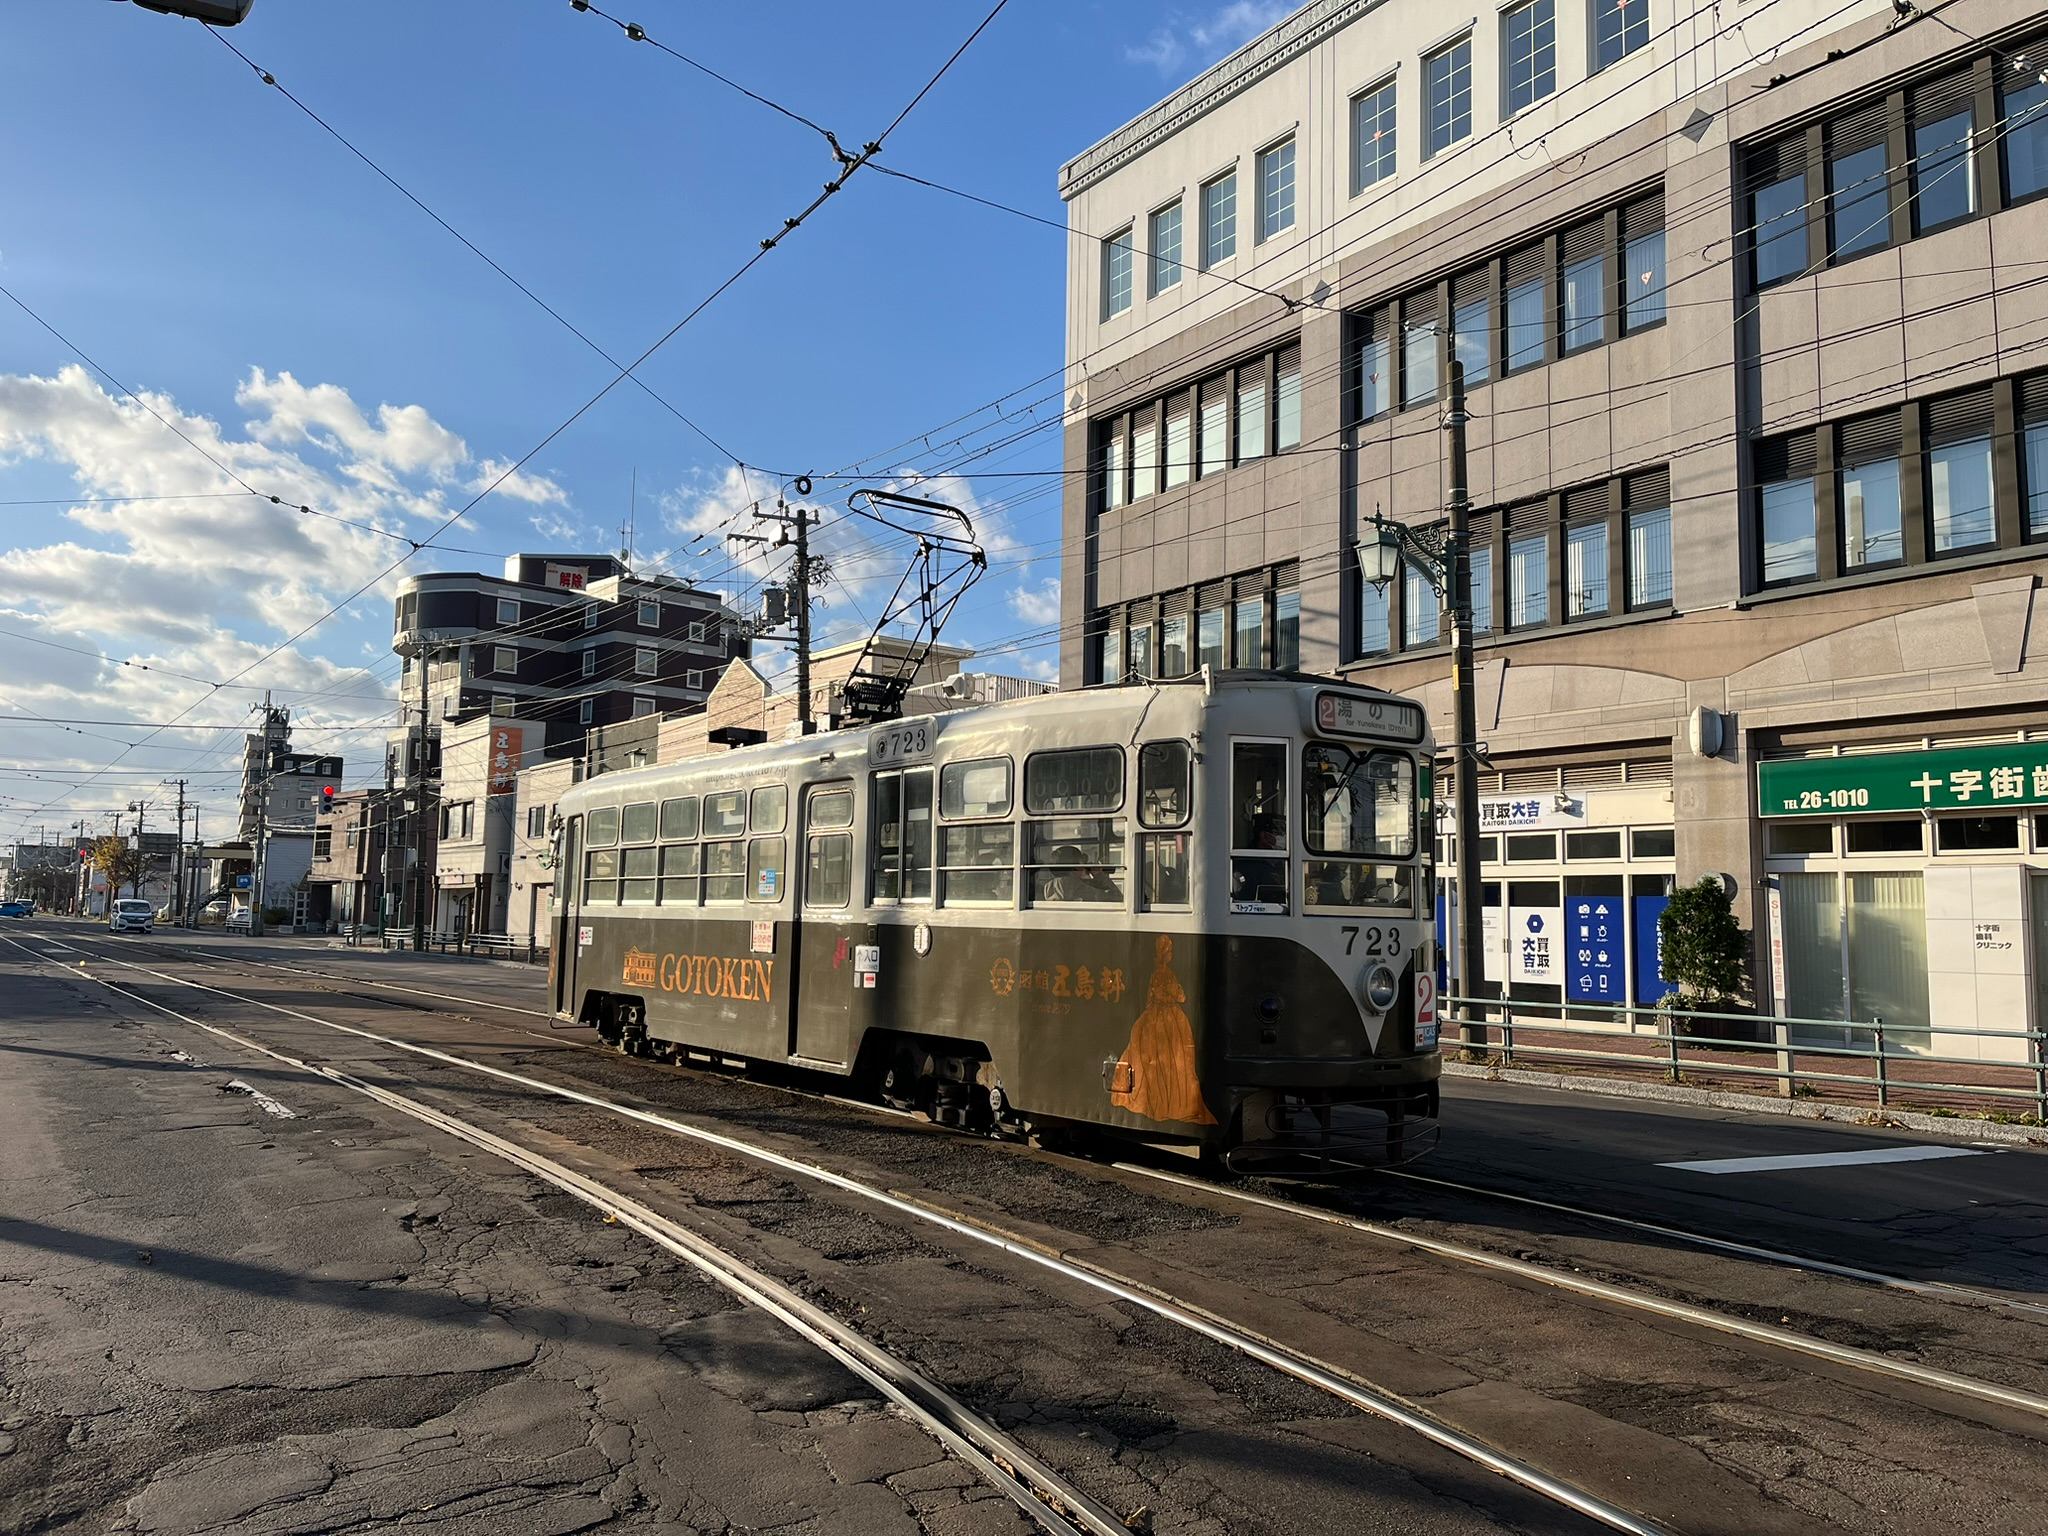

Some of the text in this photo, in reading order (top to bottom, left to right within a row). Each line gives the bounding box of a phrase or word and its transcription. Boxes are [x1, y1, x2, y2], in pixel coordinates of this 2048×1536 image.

[1321, 700, 1334, 722] 2
[891, 728, 926, 756] 723
[1783, 788, 1869, 810] TEL 26-1010
[1481, 800, 1540, 821] 買取大吉
[1482, 819, 1507, 827] KAITORI
[1975, 924, 2000, 932] 十字街
[1341, 925, 1401, 957] 723
[1976, 942, 2012, 950] クリニック
[864, 950, 878, 962] 入口
[660, 953, 774, 1003] GOTOKEN
[1418, 975, 1433, 1023] 2
